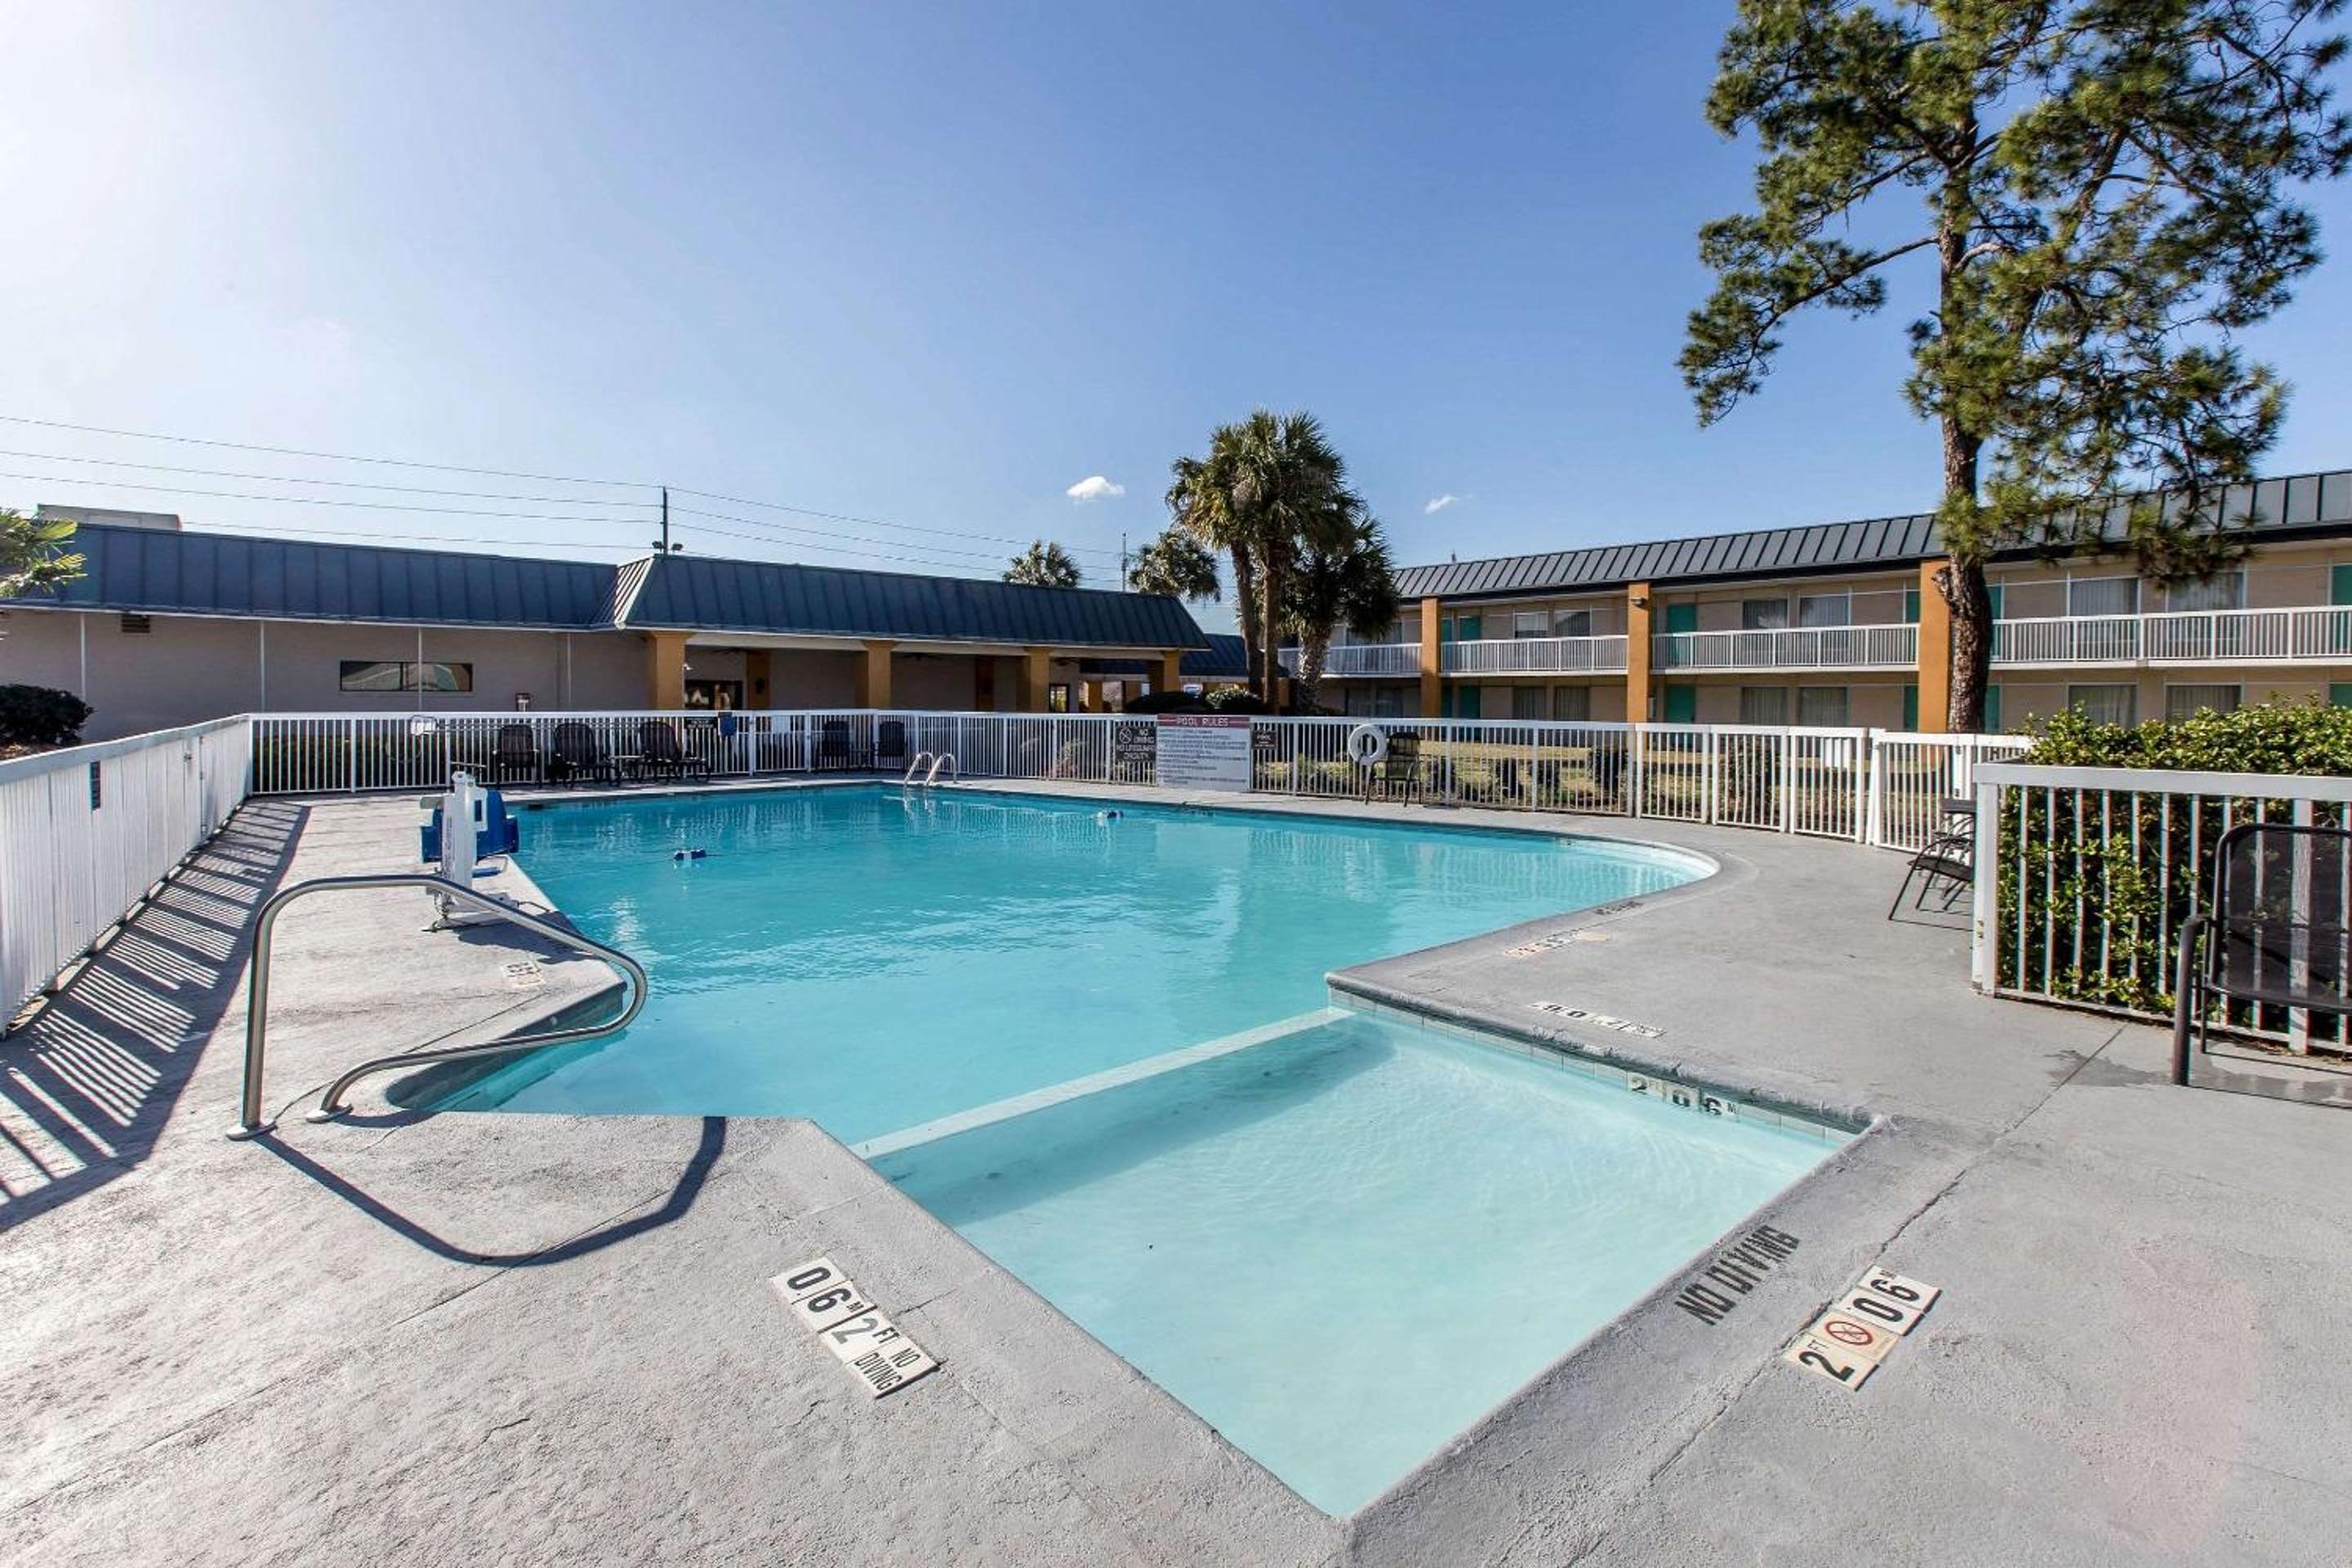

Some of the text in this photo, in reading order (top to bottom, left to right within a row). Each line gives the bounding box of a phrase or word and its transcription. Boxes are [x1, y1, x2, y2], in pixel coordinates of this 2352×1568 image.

[1177, 717, 1229, 727] POOL RULES
[1674, 1225, 1800, 1326] NO DIVING
[855, 1352, 903, 1392] DIVING
[889, 1348, 921, 1369] NO
